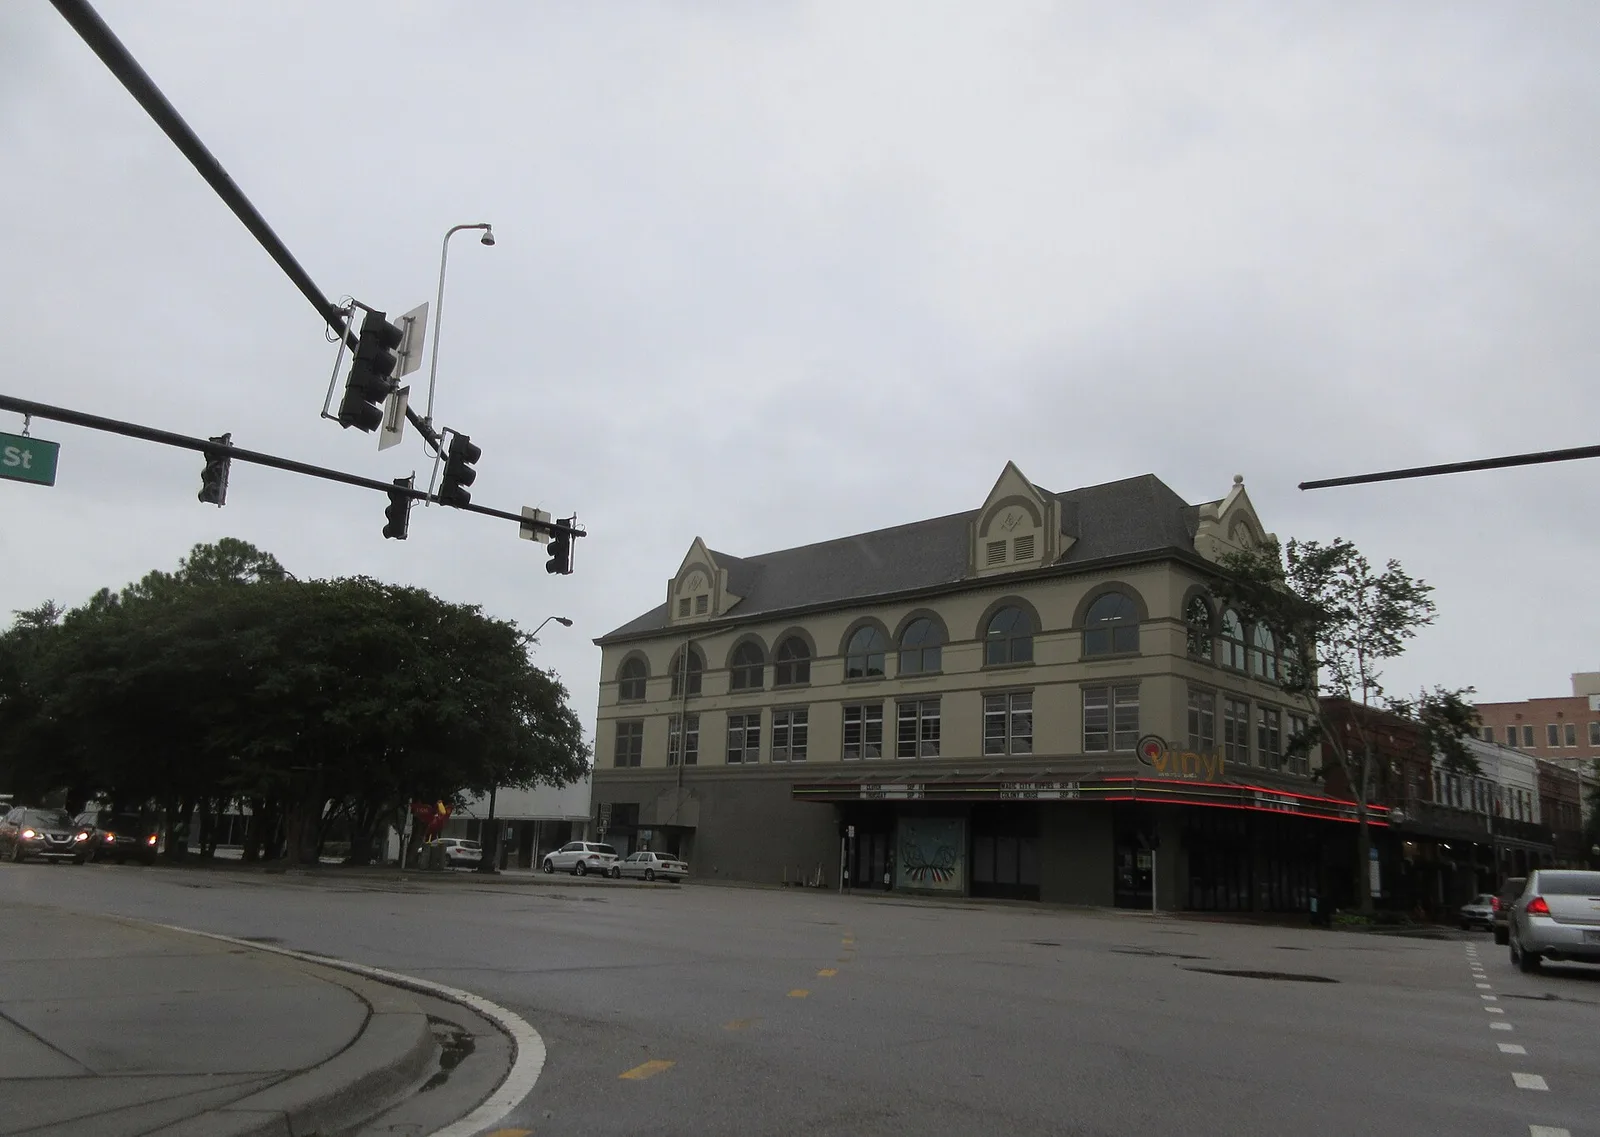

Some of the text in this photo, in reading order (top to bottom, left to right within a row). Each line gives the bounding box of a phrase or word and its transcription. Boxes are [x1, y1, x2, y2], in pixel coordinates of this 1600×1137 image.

[3, 446, 33, 469] St
[1151, 743, 1224, 782] vinyl
[1059, 791, 1068, 799] SEP
